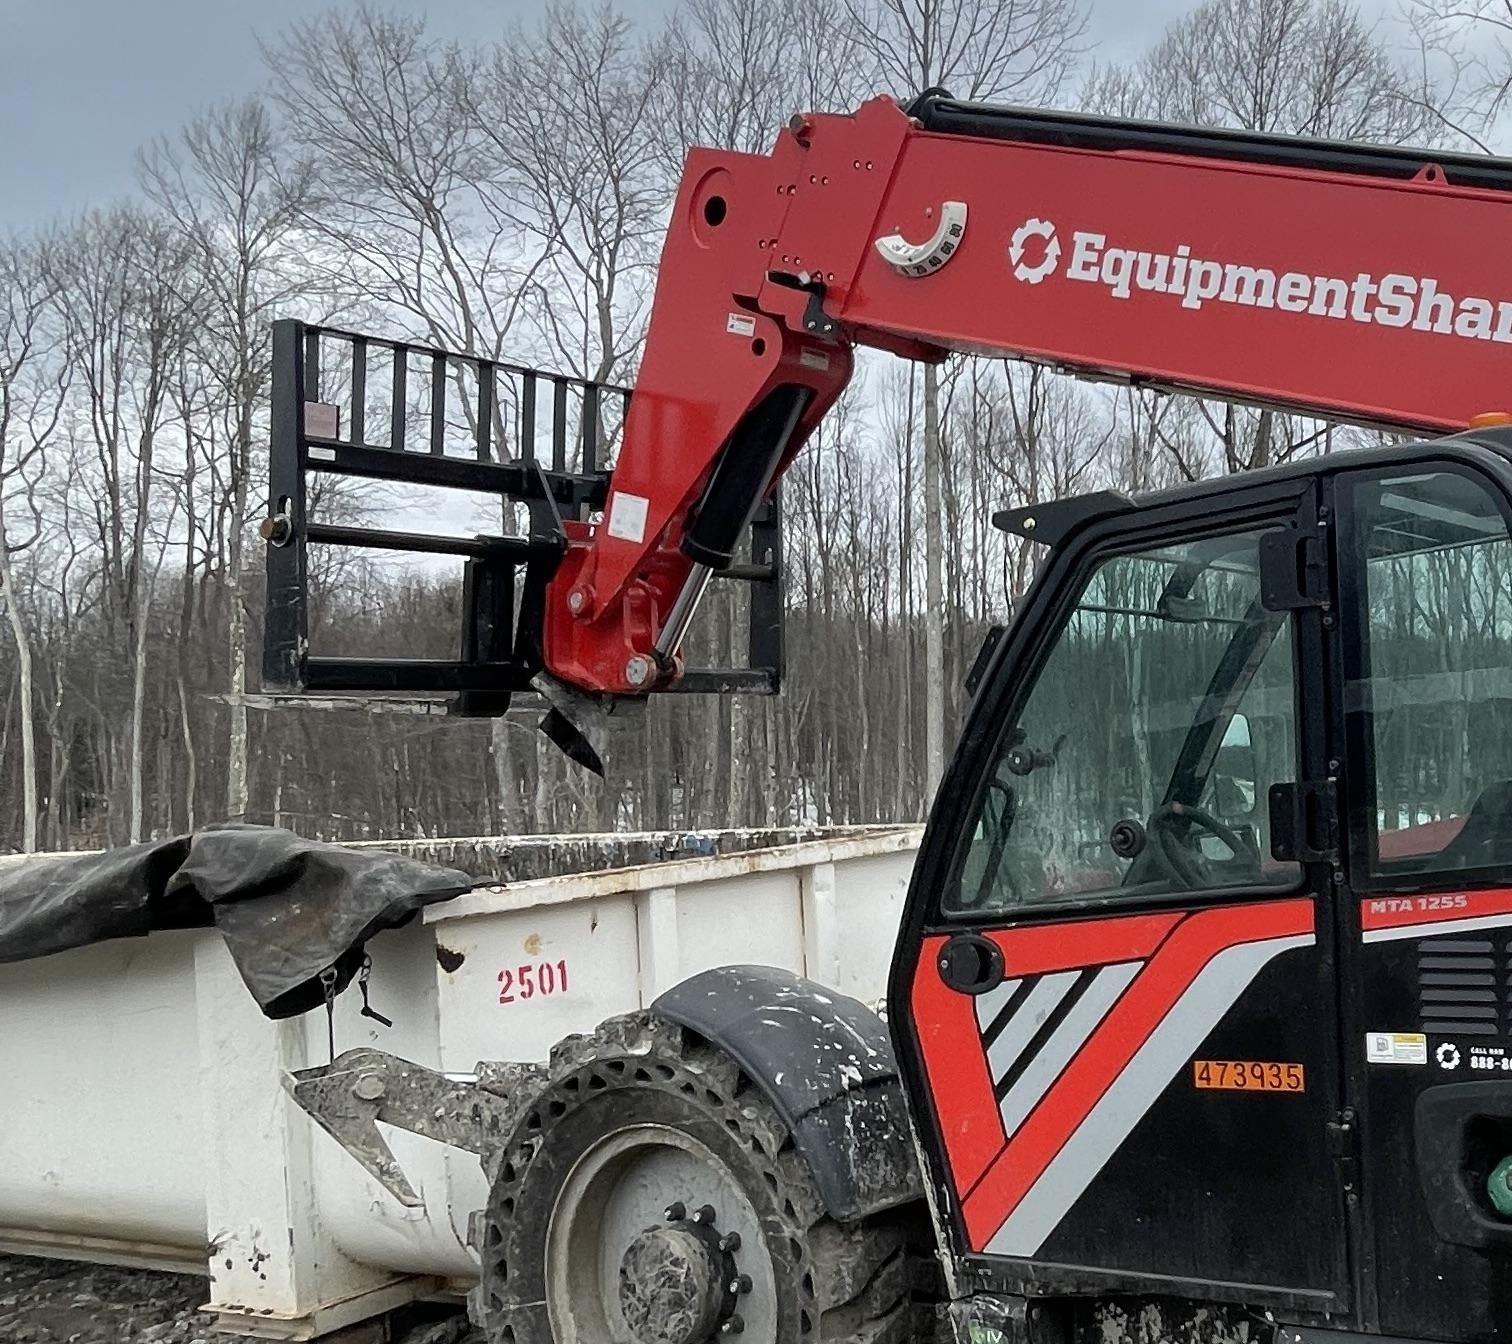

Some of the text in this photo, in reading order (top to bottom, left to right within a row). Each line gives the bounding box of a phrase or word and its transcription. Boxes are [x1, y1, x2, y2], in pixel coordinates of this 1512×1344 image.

[1370, 899, 1413, 914] MTA
[497, 959, 568, 1004] 2501
[1197, 1062, 1301, 1089] 473935
